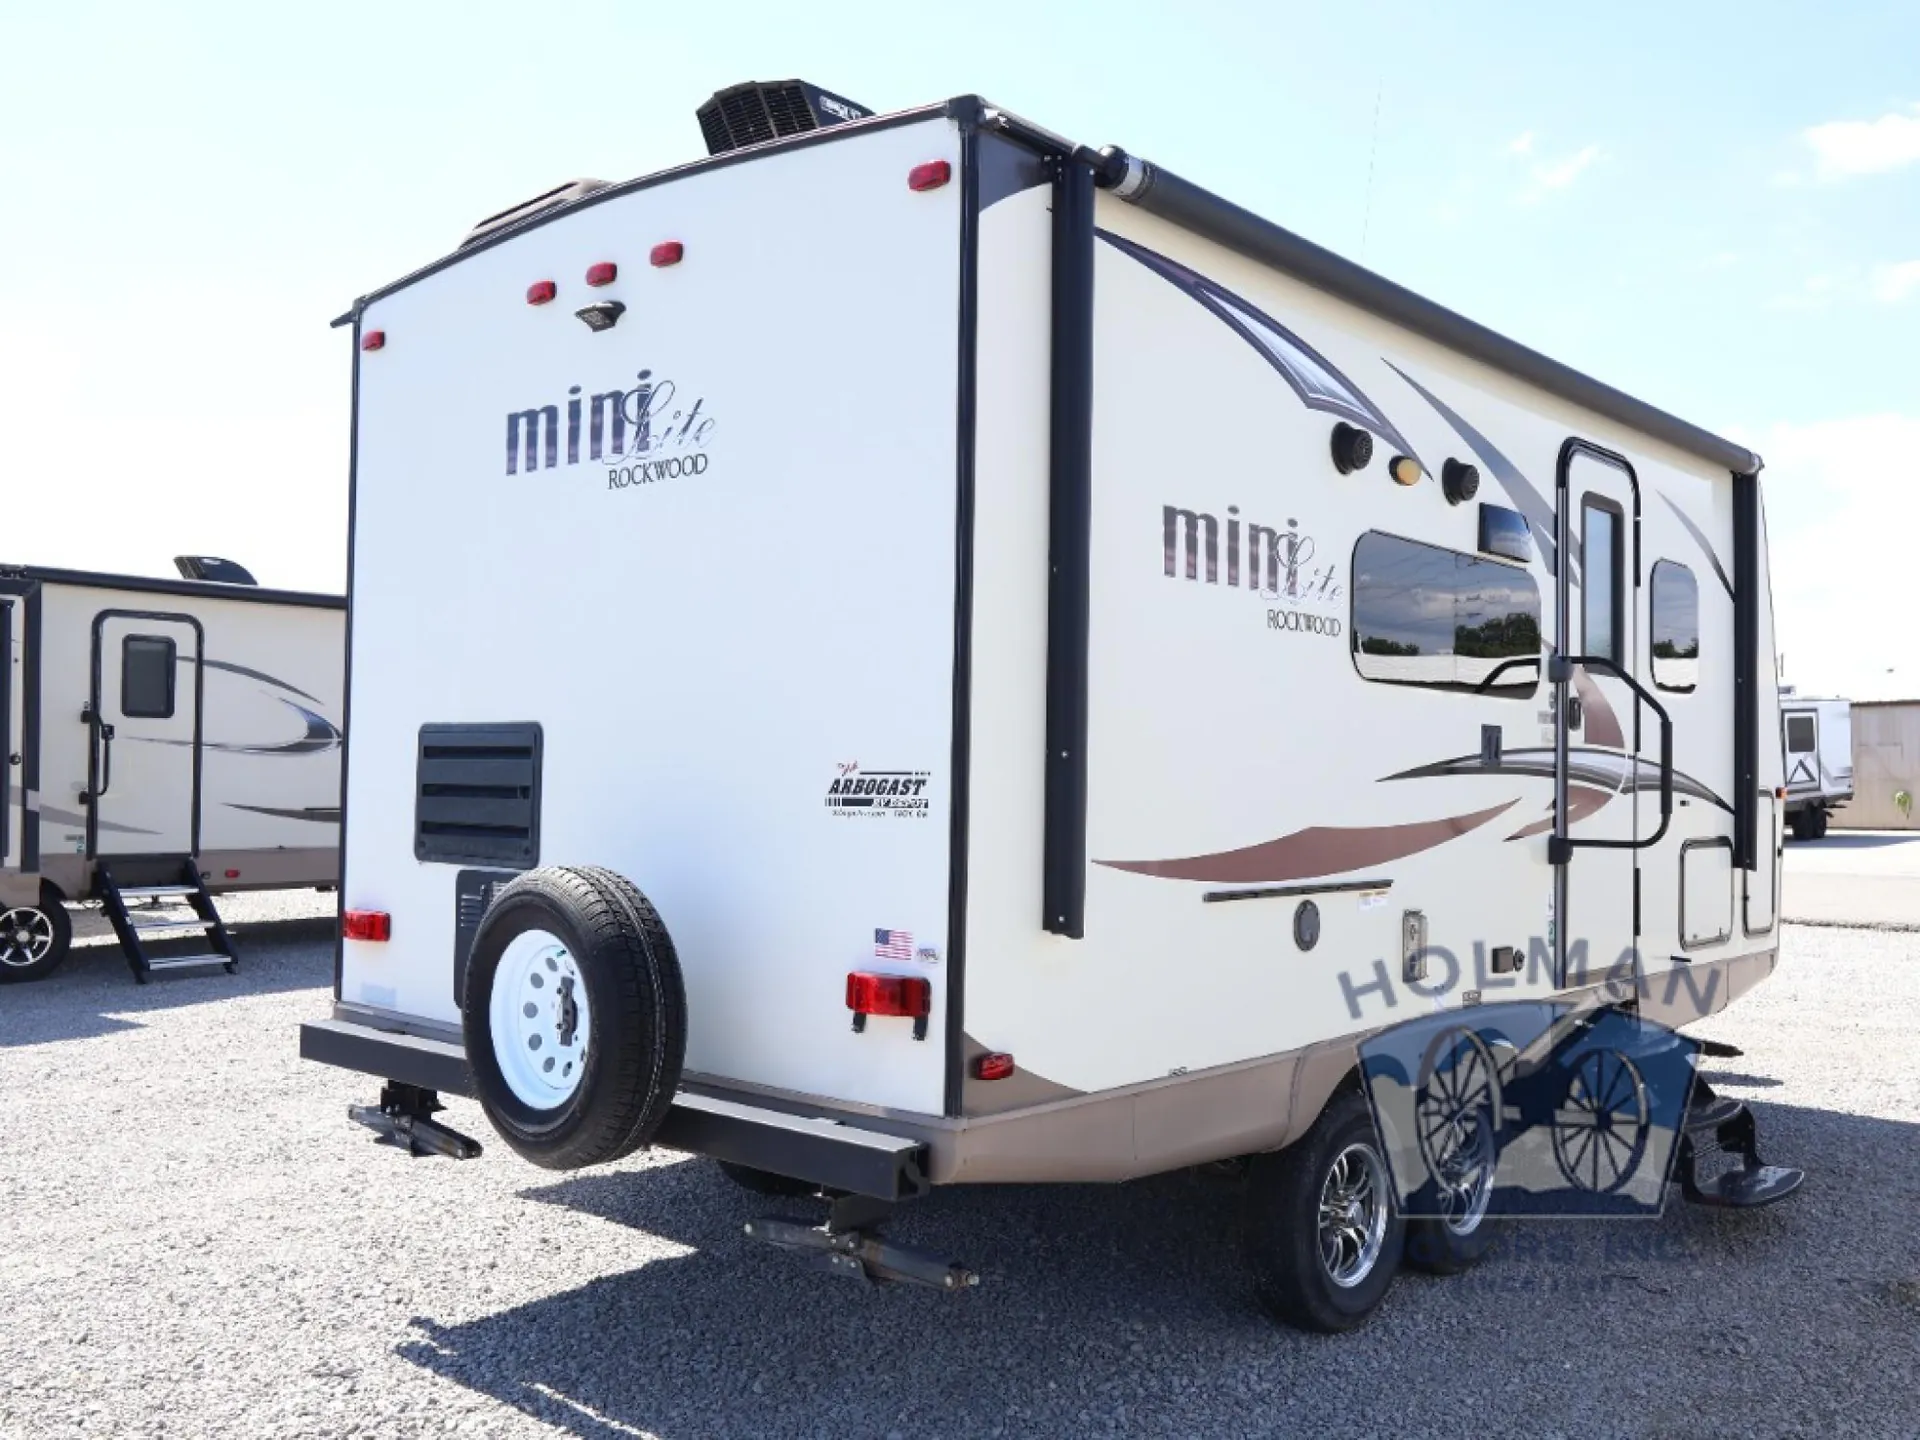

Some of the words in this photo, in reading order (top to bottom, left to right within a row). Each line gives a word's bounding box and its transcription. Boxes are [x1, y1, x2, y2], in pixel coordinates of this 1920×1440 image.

[506, 369, 652, 475] mini
[607, 453, 708, 489] ROCKWOOD
[1163, 505, 1298, 596] mini
[1267, 609, 1341, 637] ROCKWOOD
[828, 778, 927, 796] ARBOGAST
